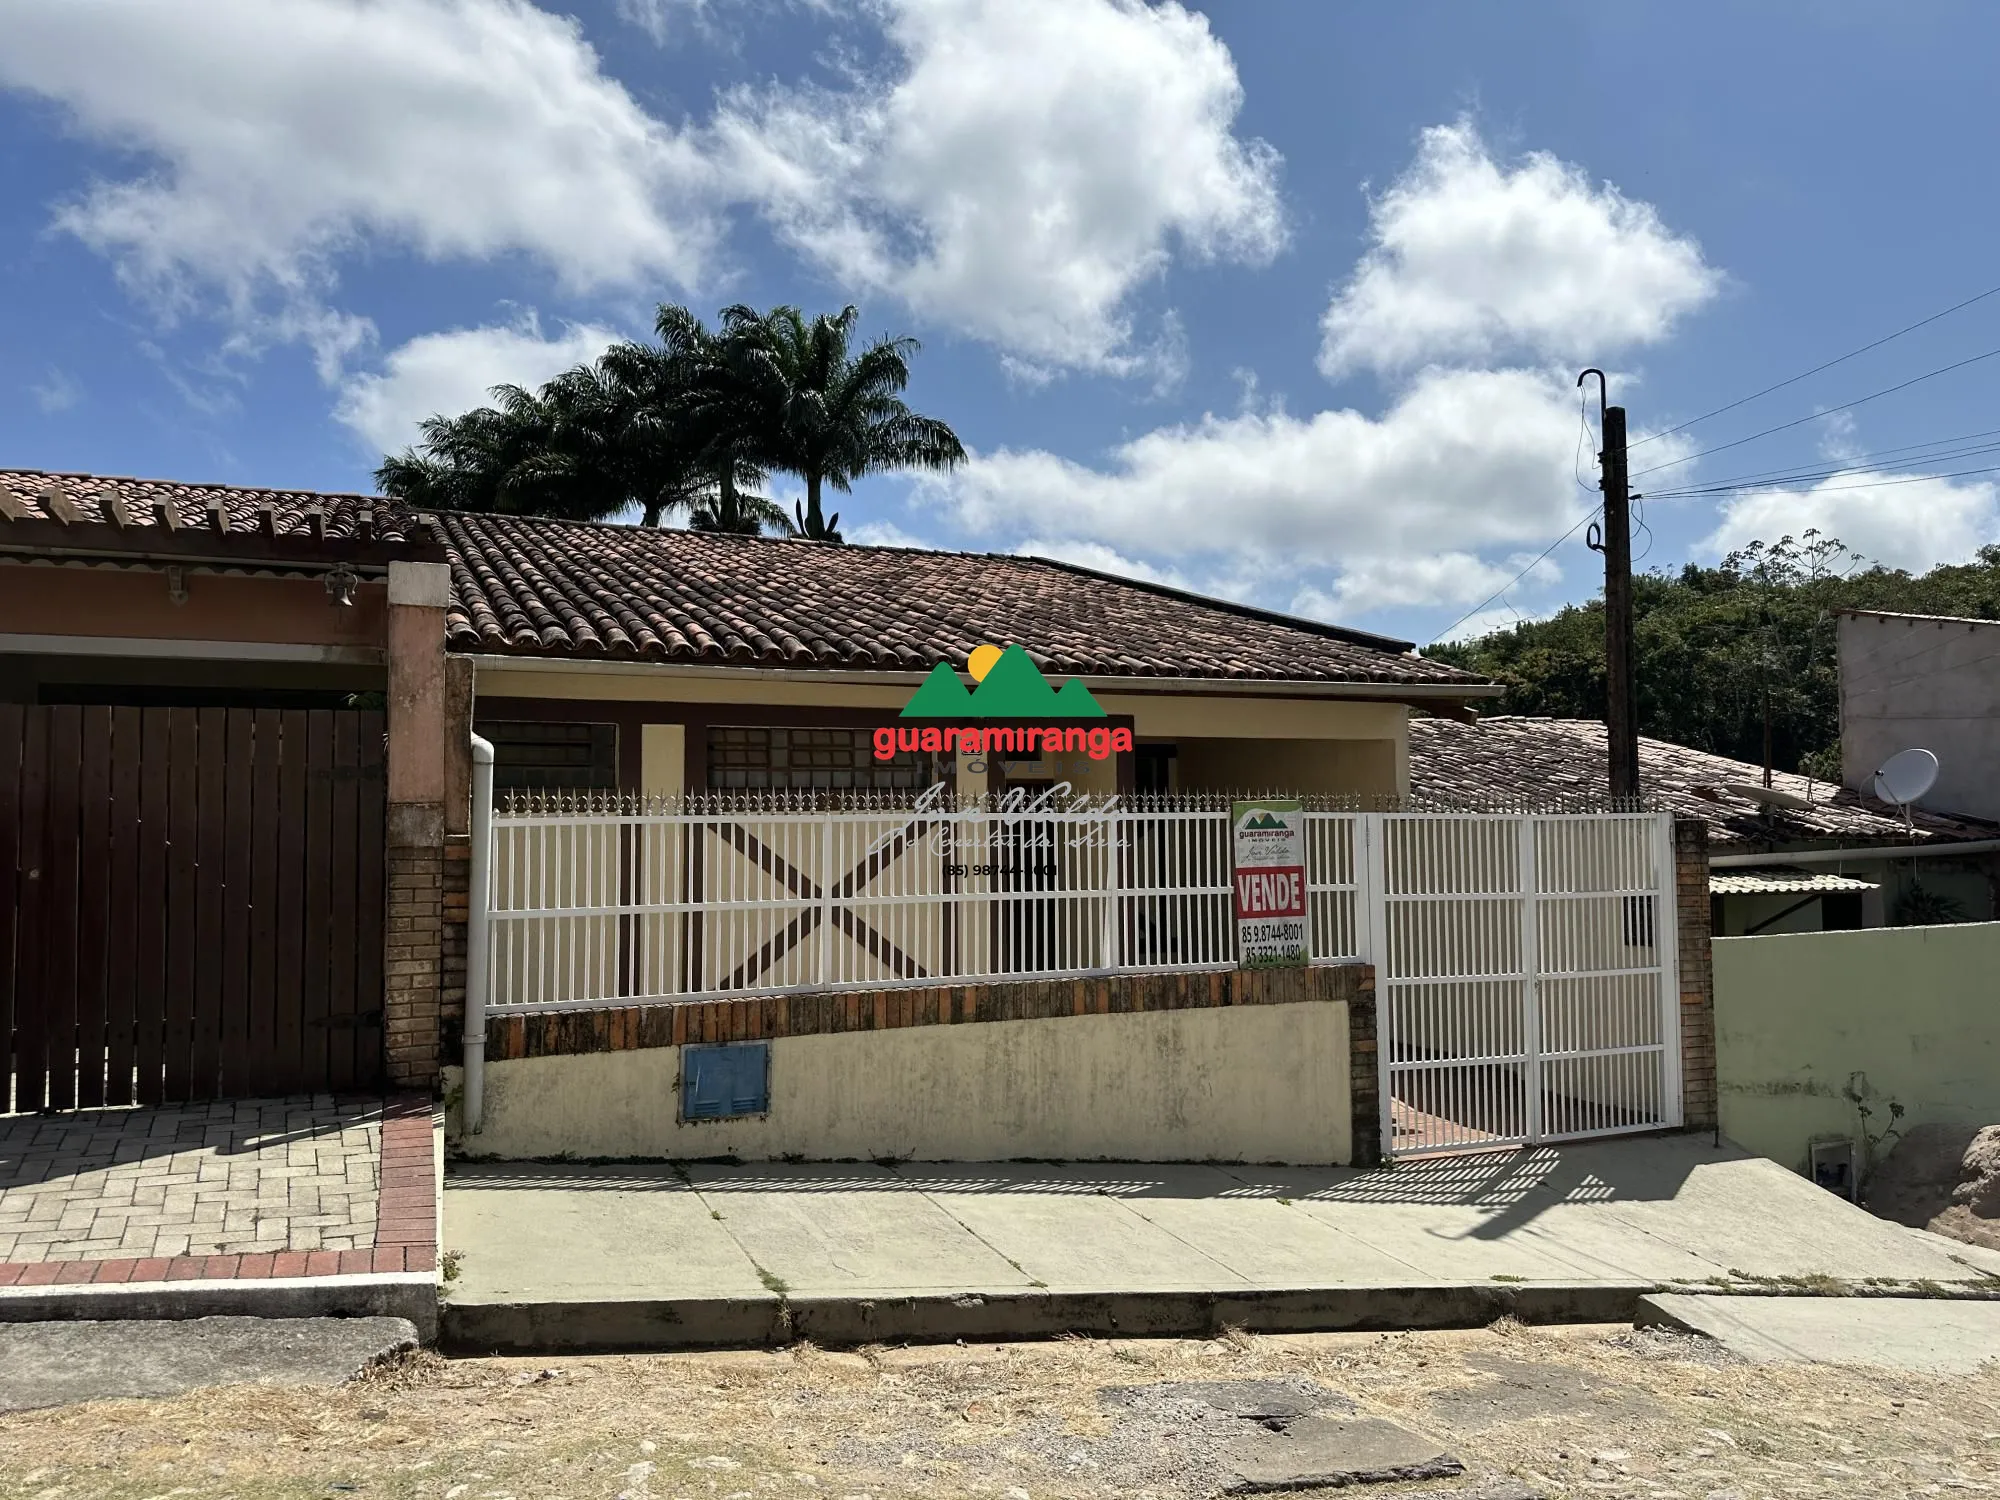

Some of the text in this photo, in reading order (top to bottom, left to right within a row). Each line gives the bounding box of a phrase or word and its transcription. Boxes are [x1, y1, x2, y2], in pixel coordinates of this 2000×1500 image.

[1239, 830, 1295, 840] guaramiranga
[1237, 872, 1301, 913] VENDE
[1242, 923, 1304, 943] 85 9.8744-8001
[1246, 943, 1301, 964] 85 3321-1480
